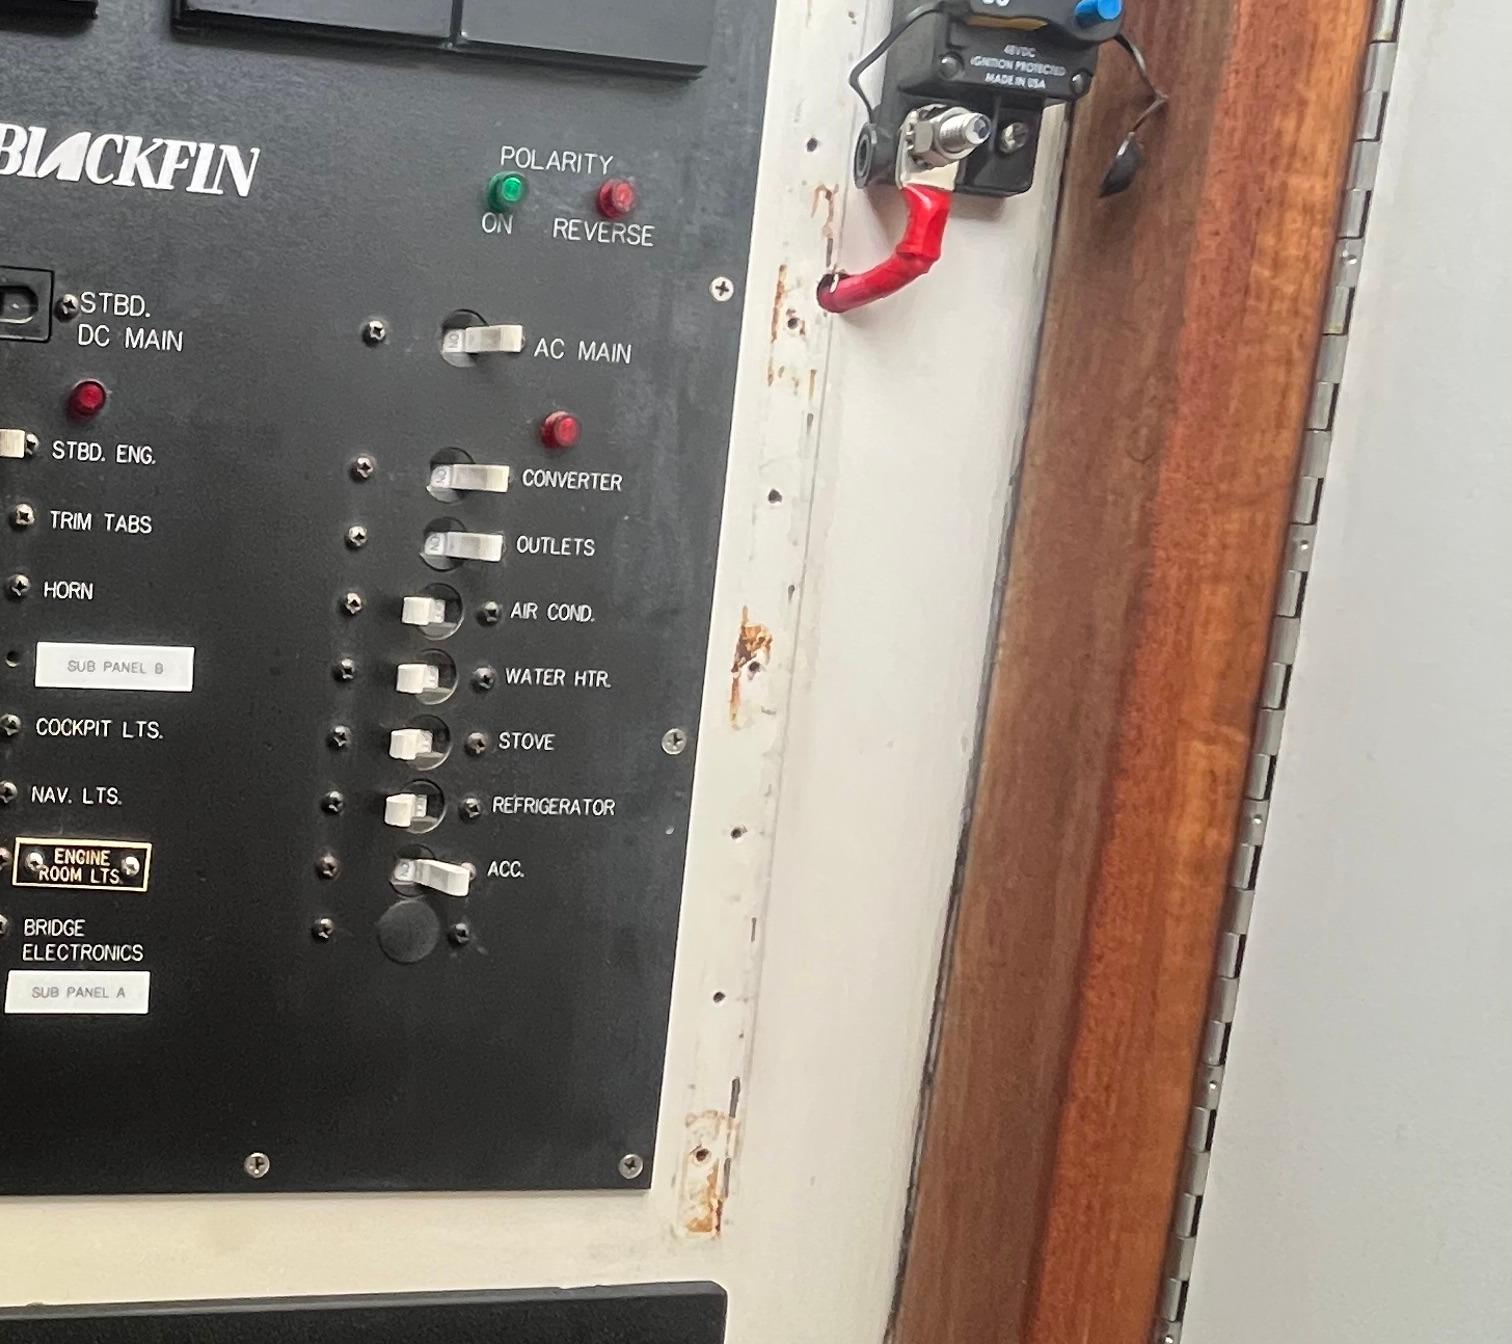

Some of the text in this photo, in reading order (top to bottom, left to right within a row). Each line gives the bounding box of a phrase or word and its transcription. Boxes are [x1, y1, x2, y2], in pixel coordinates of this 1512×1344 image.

[500, 145, 614, 175] POLARITY
[481, 211, 514, 235] ON
[552, 216, 656, 248] REVERSE
[80, 291, 151, 319] STBD.
[77, 323, 184, 353] DC MAIN
[534, 338, 632, 364] AC MAIN
[52, 440, 157, 466] STBD. ENG.
[522, 468, 623, 493] CONVERTER
[50, 509, 153, 534] TRIM TABS
[516, 534, 596, 557] OUTLETS
[43, 581, 94, 600] HORN
[510, 601, 595, 624] AIR COND.
[67, 659, 96, 674] SUB
[103, 659, 147, 675] PANEL
[505, 667, 566, 687] WATER
[35, 717, 164, 739] COCKPIT LTS.
[498, 731, 556, 752] STOVE
[31, 786, 123, 806] NAV. LTS.
[492, 794, 616, 817] REFRIGERATOR
[53, 847, 112, 867] ENGINE
[38, 866, 123, 885] ROOM LTS.
[486, 860, 525, 879] ACC.
[24, 918, 86, 938] BRIDGE
[22, 943, 144, 963] ELECTRONICS
[31, 986, 126, 999] SUB PANEL A
